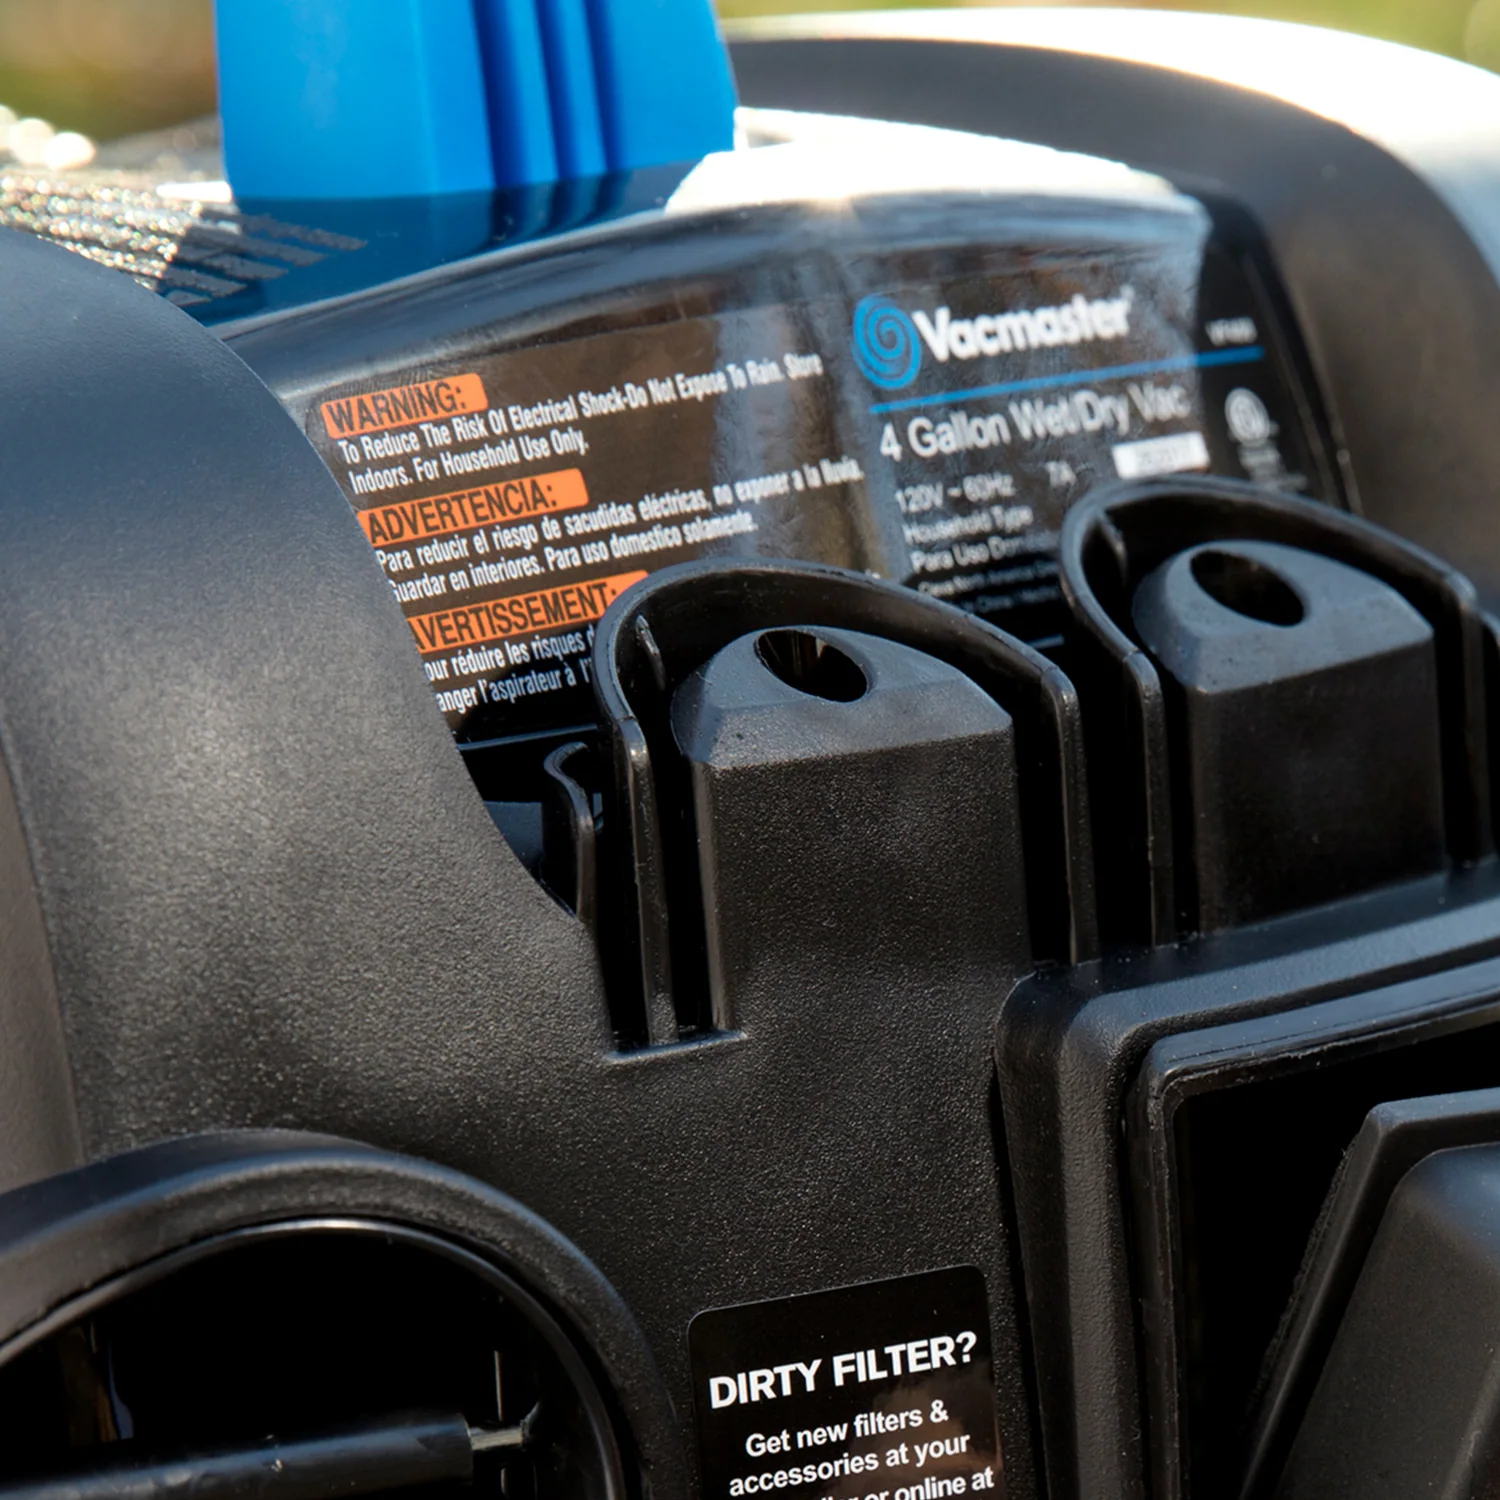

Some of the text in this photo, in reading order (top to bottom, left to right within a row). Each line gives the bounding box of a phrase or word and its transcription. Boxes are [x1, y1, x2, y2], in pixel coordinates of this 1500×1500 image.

[913, 295, 1131, 362] Vacmaster
[328, 383, 466, 433] WARNING:
[338, 440, 360, 465] To
[361, 429, 419, 461] Reduce
[420, 422, 450, 448] The
[451, 415, 489, 443] Risk
[509, 396, 579, 431] Electrical
[578, 384, 649, 418] Shock-Do
[648, 378, 678, 405] Not
[675, 371, 728, 402] Expose
[726, 365, 748, 389] To
[881, 424, 902, 463] 4
[908, 411, 1012, 458] Gallon
[1009, 391, 1130, 441] Wet/Dry
[1127, 383, 1191, 422] Vac
[349, 426, 589, 496] Indoors. For Household Use Only.
[369, 480, 558, 544] ADVERTENCIA:
[896, 484, 943, 514] 120V
[376, 550, 413, 574] Para
[417, 530, 469, 568] reducir
[474, 529, 490, 554] el
[491, 523, 538, 557] riesgo
[542, 516, 562, 541] de
[564, 503, 636, 537] sacudidas
[639, 491, 713, 521] eléctricas,
[450, 571, 470, 594] en
[471, 554, 545, 588] interiores.
[545, 543, 583, 572] Para
[584, 541, 609, 565] uso
[610, 524, 683, 559] domestico
[683, 511, 759, 544] solamente.
[424, 658, 450, 683] our
[451, 647, 506, 679] réduire
[505, 641, 530, 667] les
[532, 633, 585, 666] risques
[436, 683, 479, 715] anger
[565, 663, 576, 686] à
[709, 1331, 977, 1409] DIRTY FILTER?
[745, 1399, 949, 1458] Get new filters &
[728, 1433, 971, 1498] accessories at your
[971, 1465, 995, 1492] at
